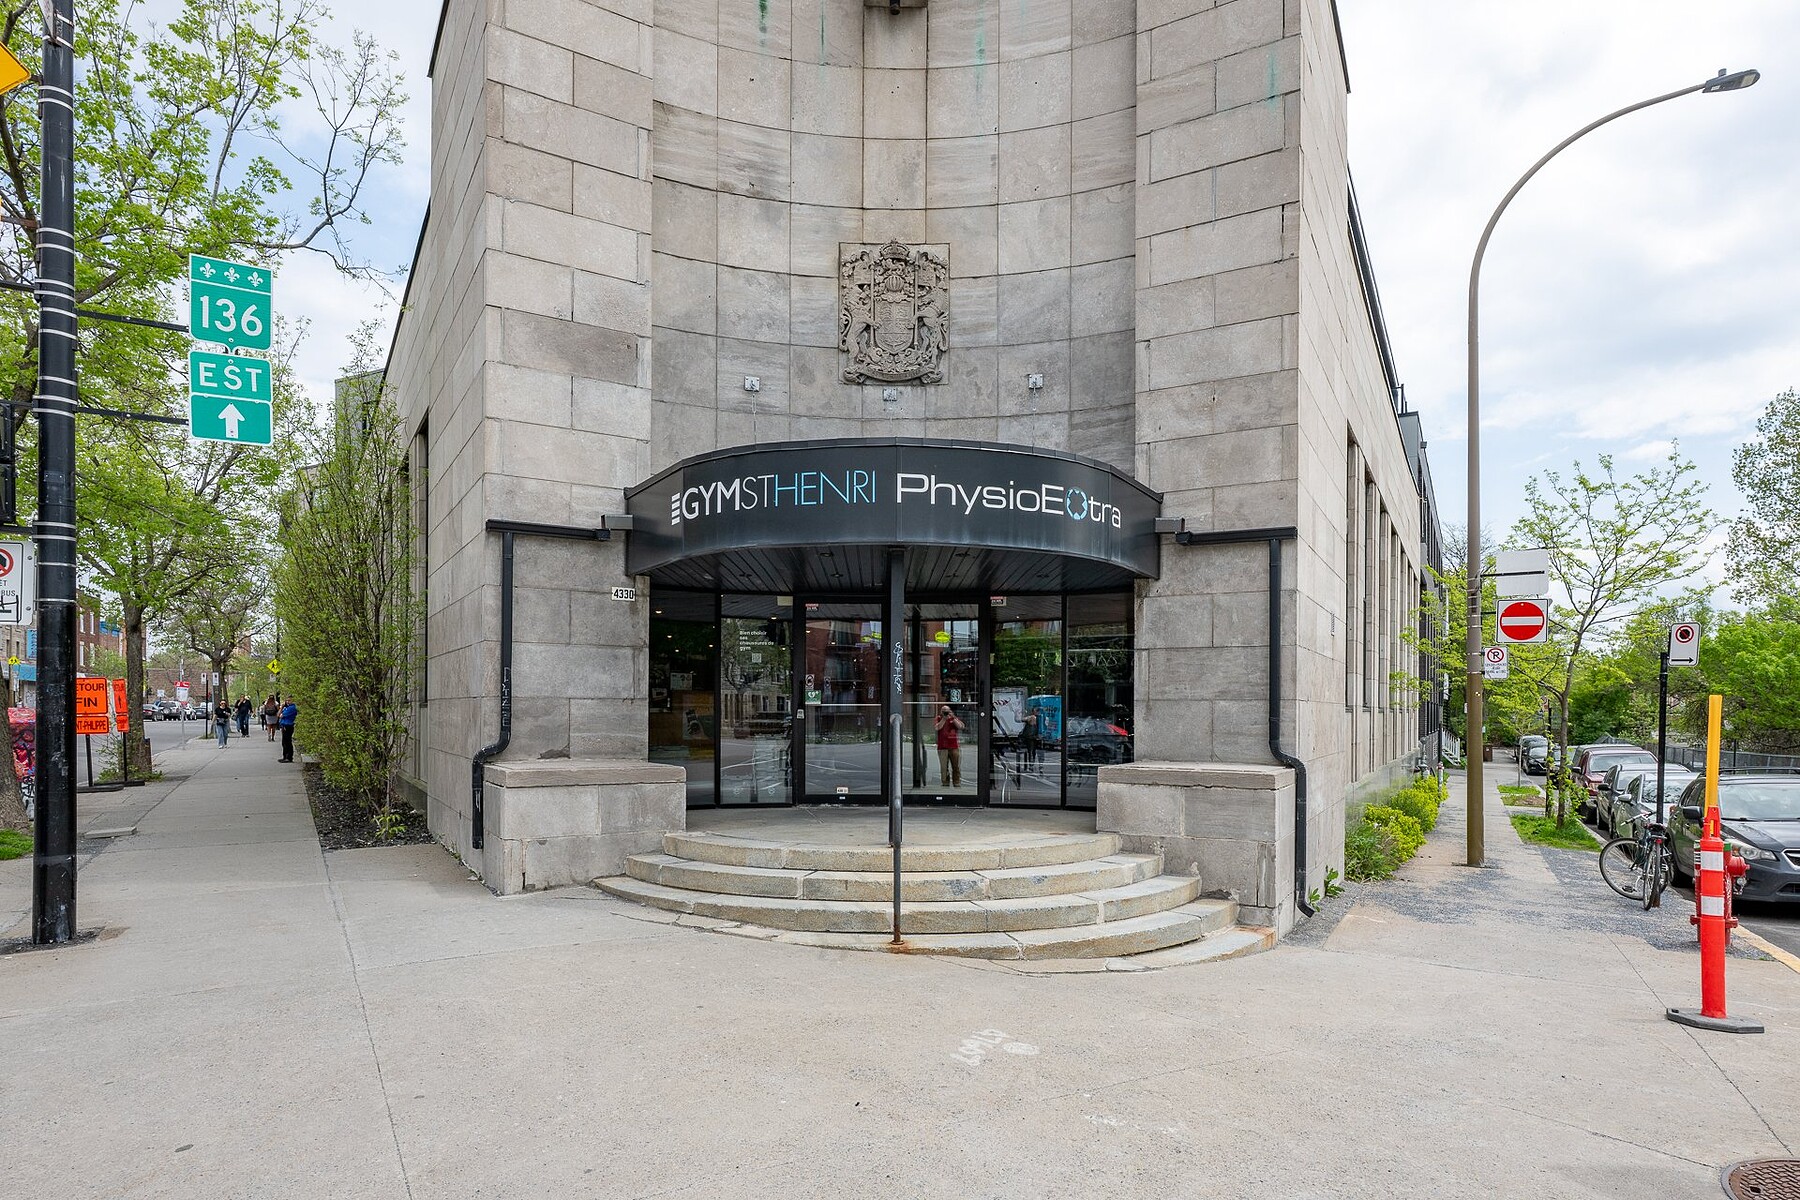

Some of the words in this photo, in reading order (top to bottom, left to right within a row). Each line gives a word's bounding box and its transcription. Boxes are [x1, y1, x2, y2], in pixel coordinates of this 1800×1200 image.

[200, 295, 263, 337] 136
[199, 362, 262, 393] EST
[1, 589, 16, 597] BUS
[613, 589, 634, 600] 4330
